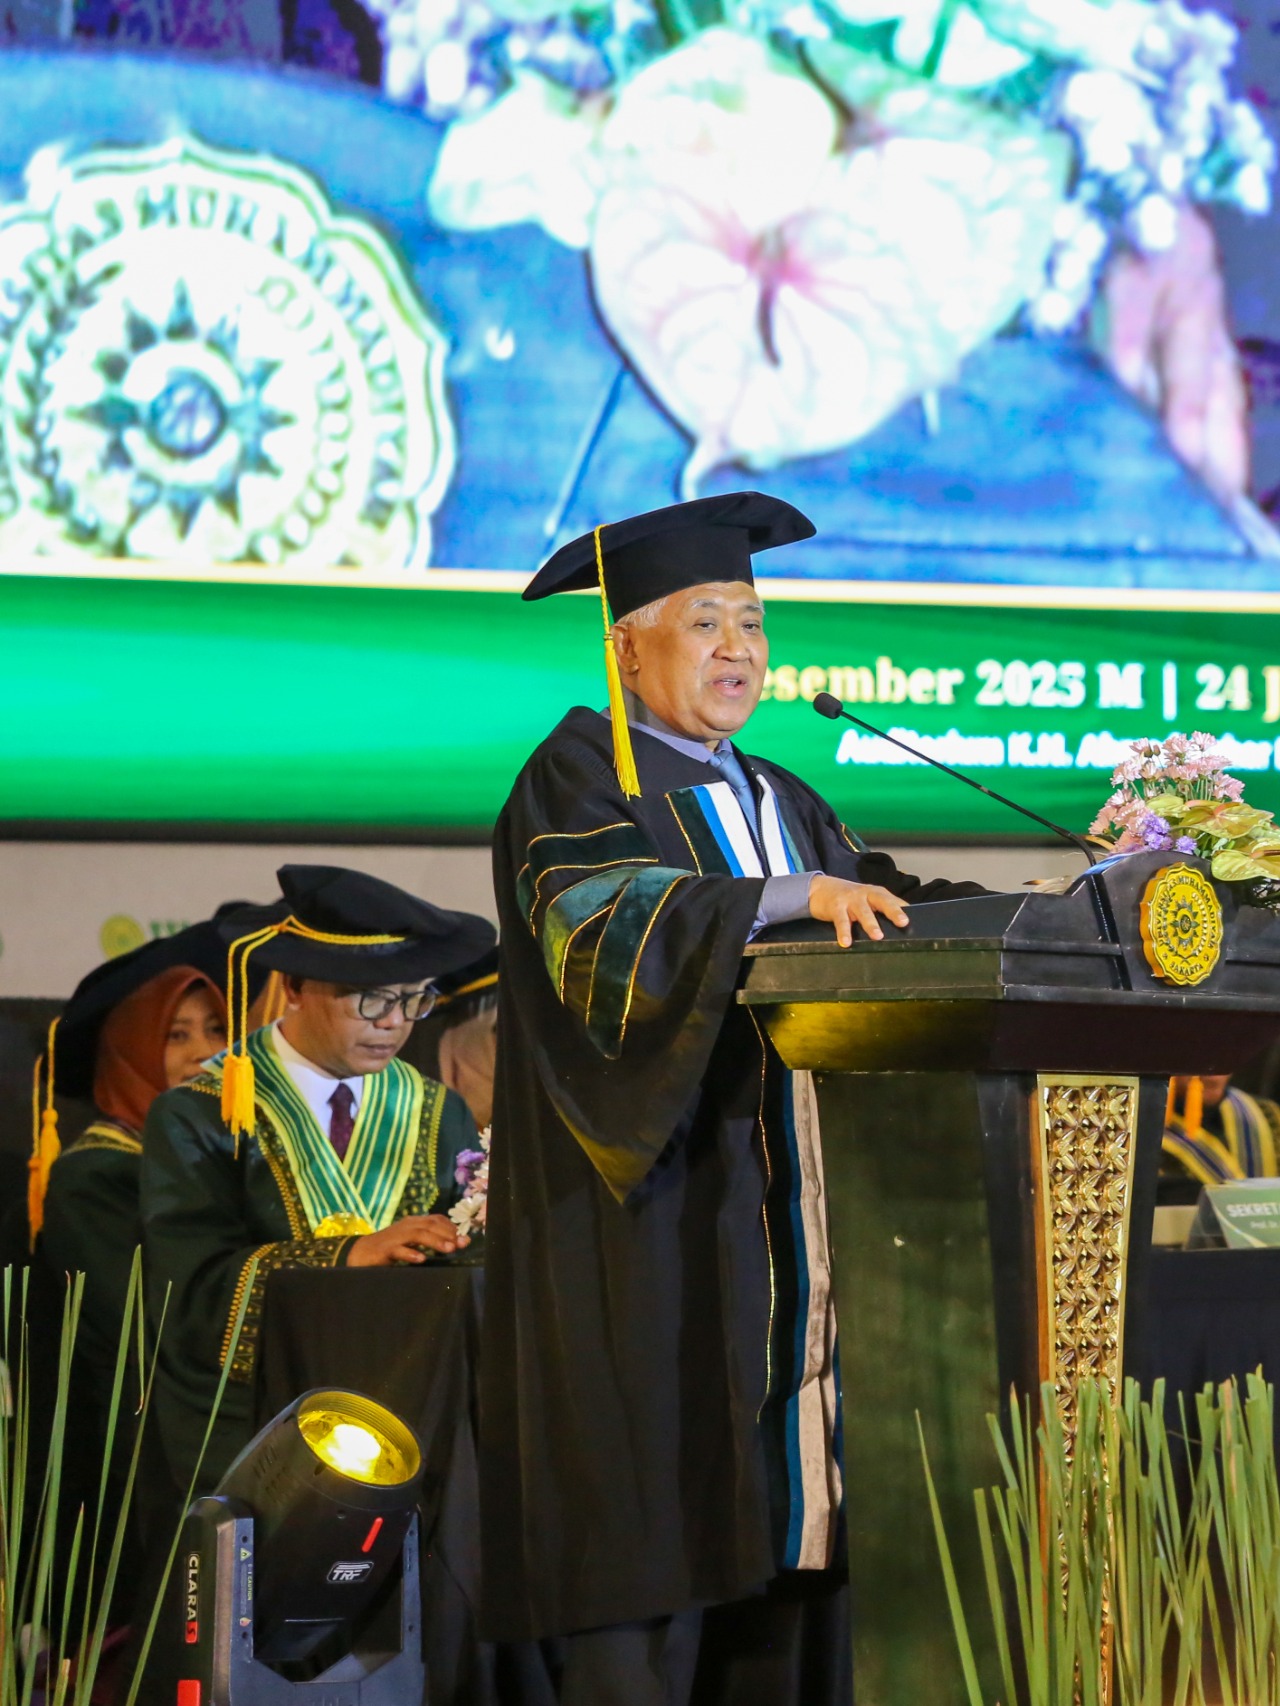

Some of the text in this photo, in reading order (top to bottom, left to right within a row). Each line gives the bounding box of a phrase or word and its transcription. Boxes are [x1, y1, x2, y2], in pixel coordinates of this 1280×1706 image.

[760, 656, 965, 704] sember
[976, 660, 1087, 709] 2025
[1096, 662, 1144, 709] M
[1196, 664, 1252, 712] 24
[188, 1556, 199, 1620] CLARA
